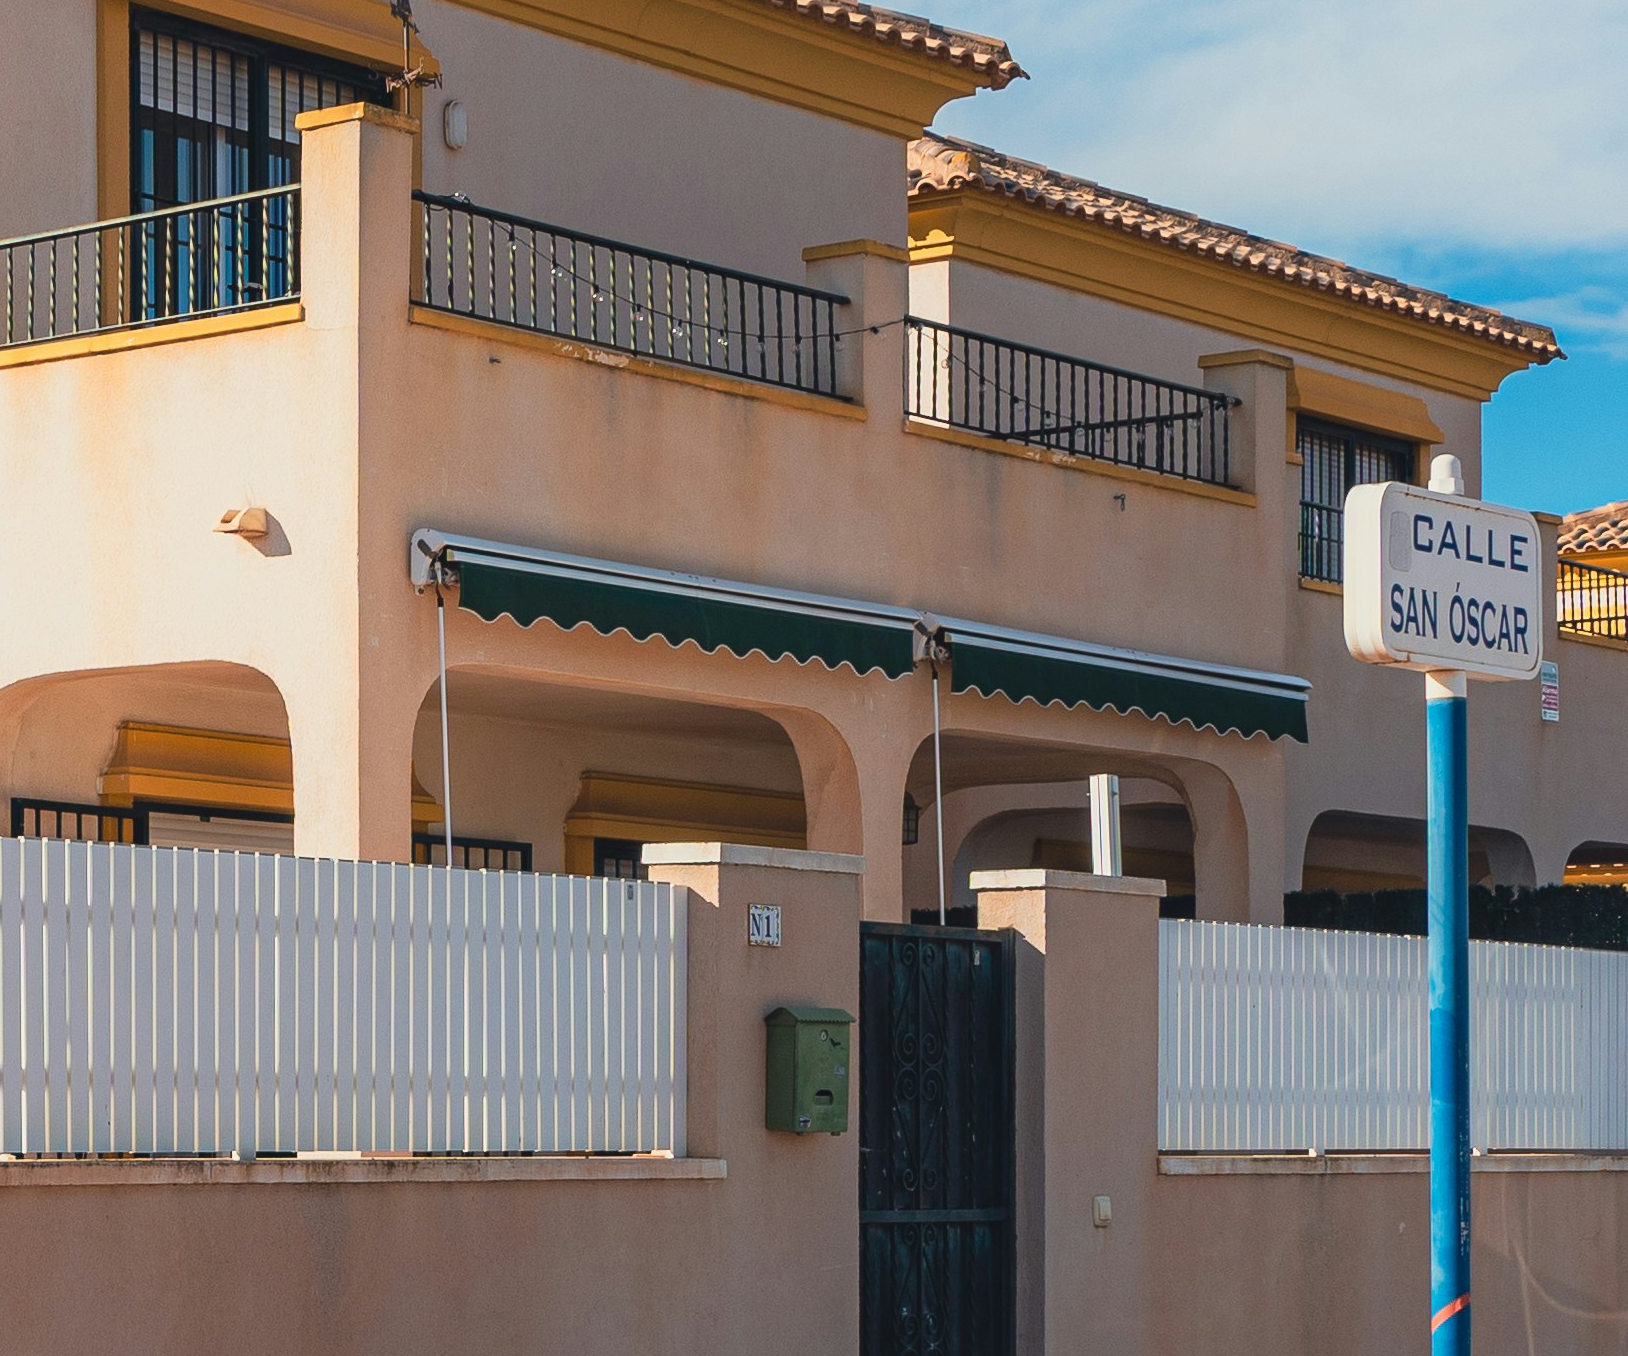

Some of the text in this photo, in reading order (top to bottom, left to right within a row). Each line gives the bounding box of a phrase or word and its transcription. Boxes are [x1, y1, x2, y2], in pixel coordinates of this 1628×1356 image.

[1413, 514, 1529, 573] CALLE
[1390, 582, 1530, 655] SAN ÓSCAR
